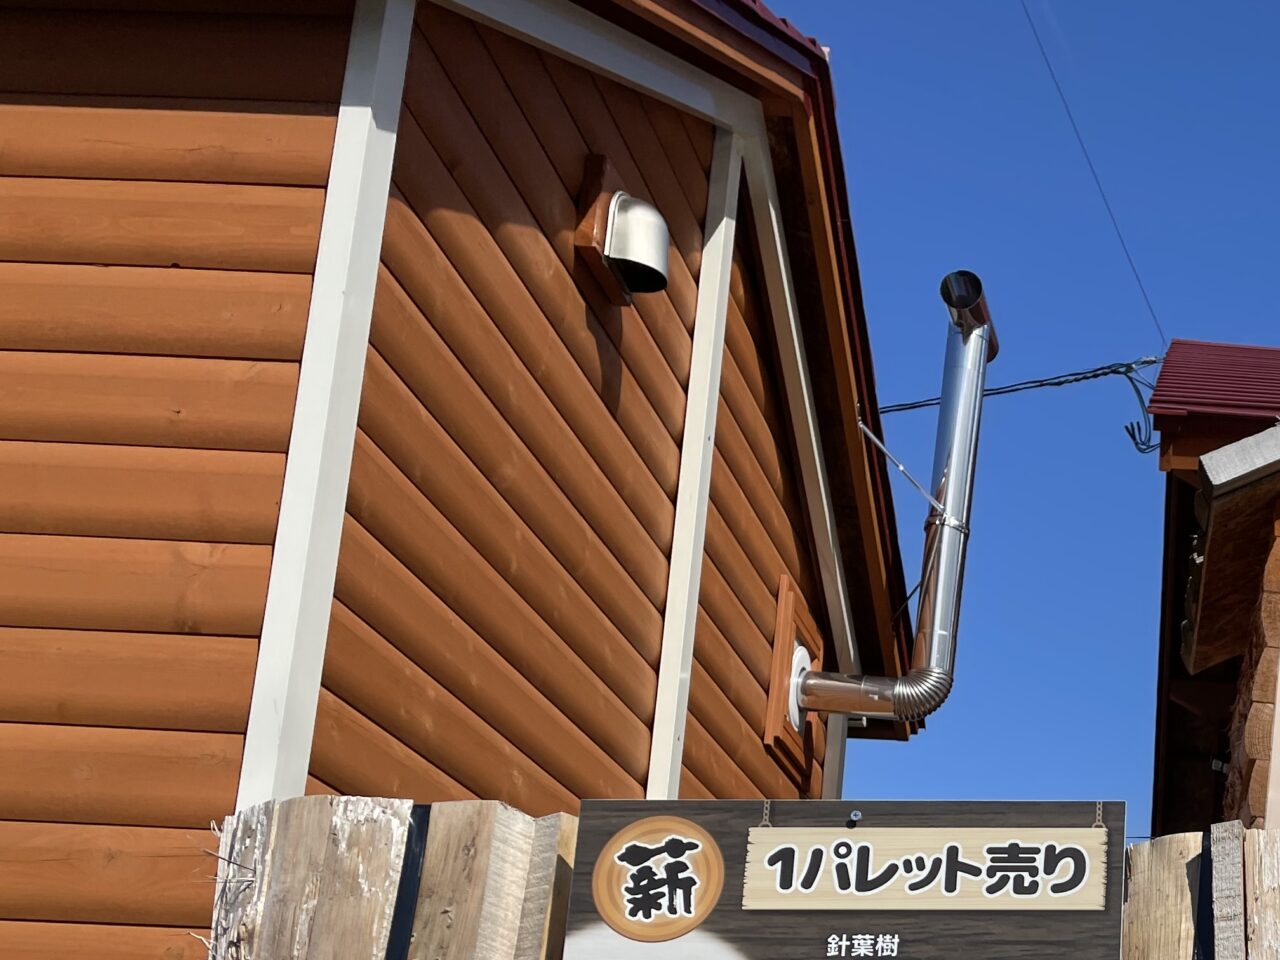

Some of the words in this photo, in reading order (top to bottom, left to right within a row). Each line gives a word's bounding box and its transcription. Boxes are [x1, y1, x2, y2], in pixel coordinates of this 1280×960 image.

[615, 837, 701, 920] 薪
[765, 842, 1088, 894] 1パレット売り
[826, 934, 900, 957] 針葉樹
